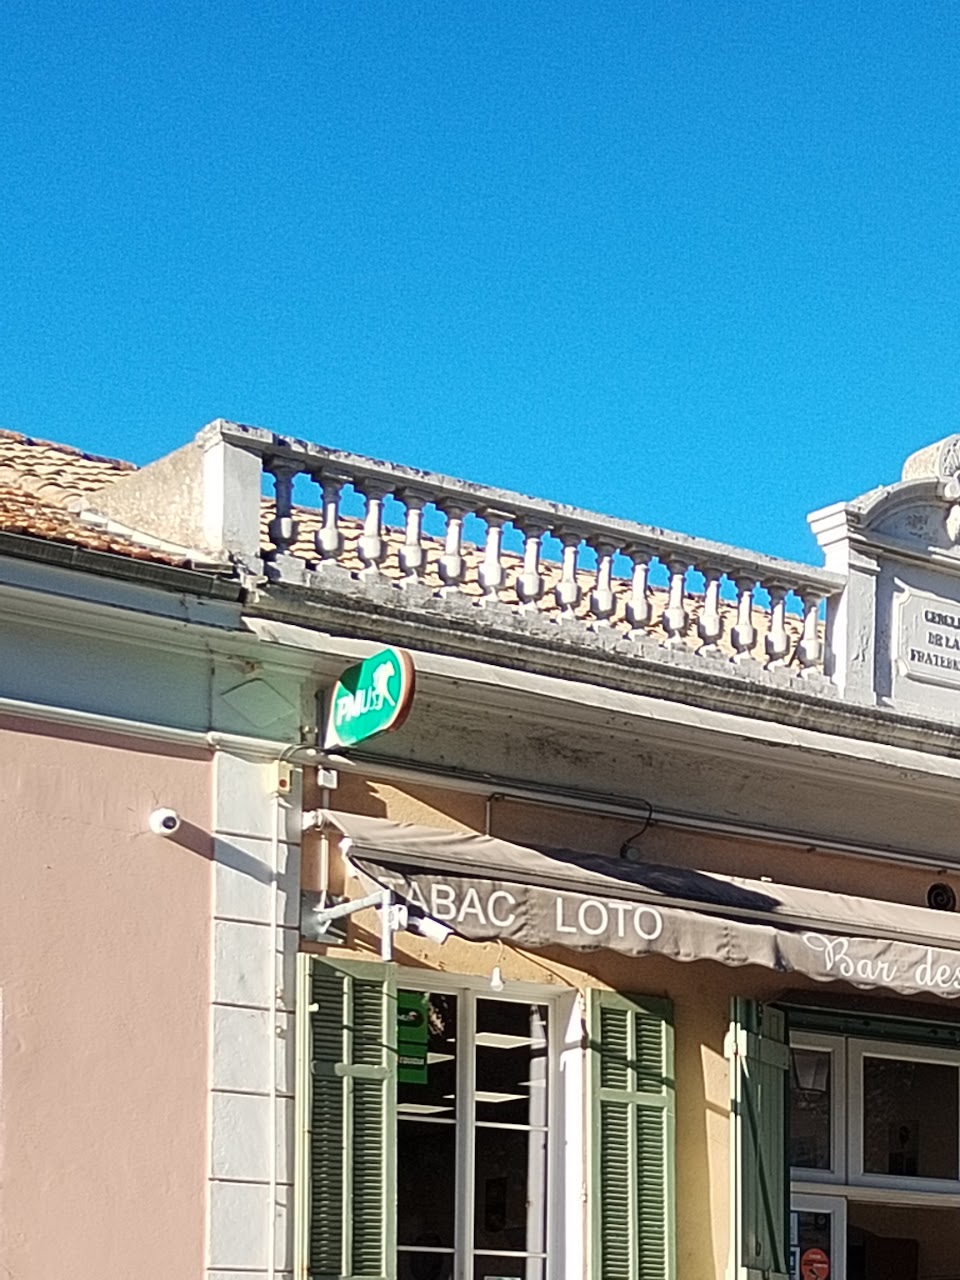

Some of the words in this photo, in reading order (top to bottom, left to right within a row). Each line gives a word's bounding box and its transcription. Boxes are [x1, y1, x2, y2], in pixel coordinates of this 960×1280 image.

[928, 632, 943, 647] DE
[944, 637, 960, 651] LA
[336, 686, 373, 726] PMU
[555, 895, 664, 941] LOTO
[802, 932, 900, 984] Bar
